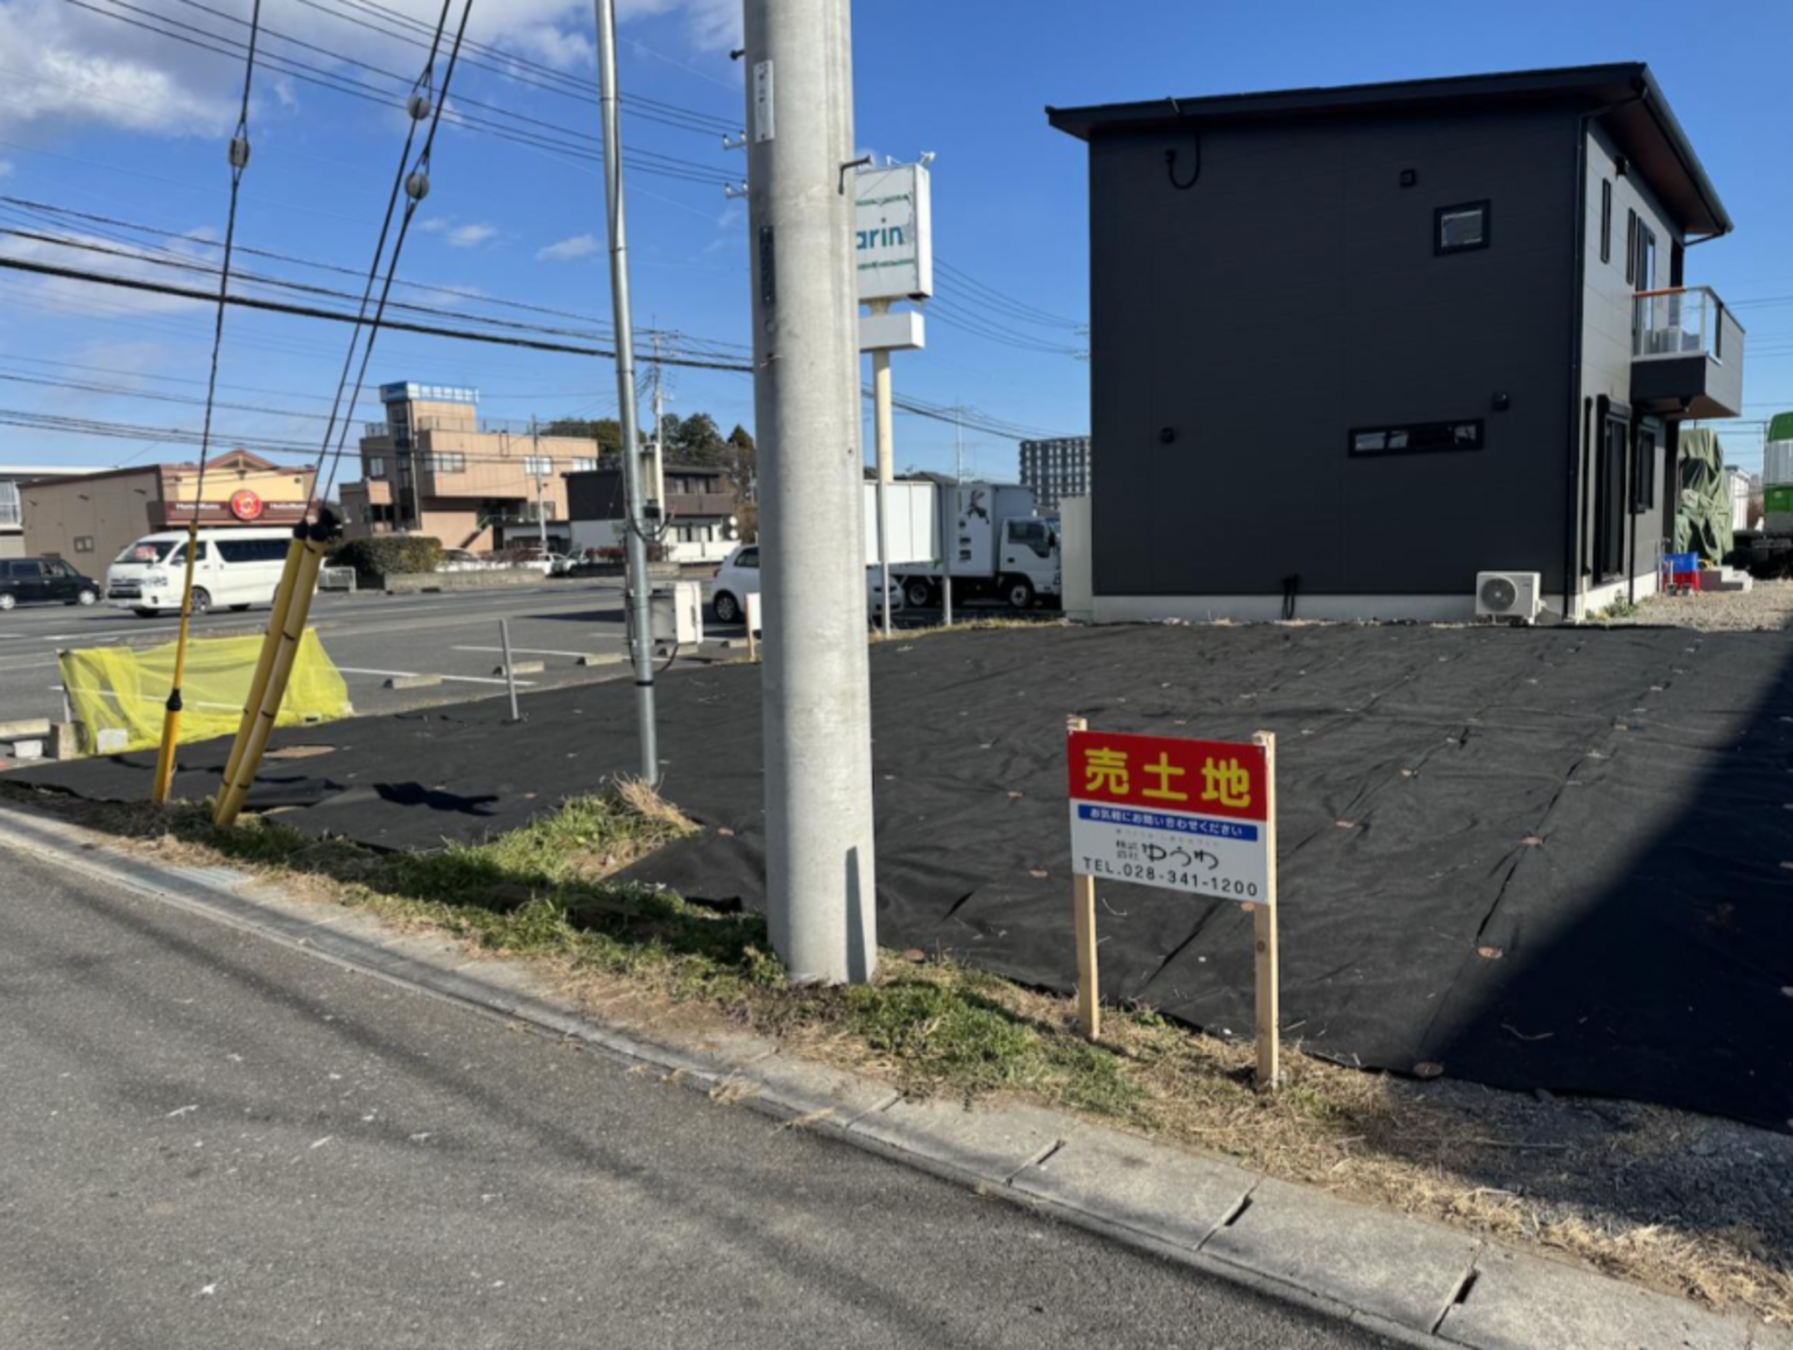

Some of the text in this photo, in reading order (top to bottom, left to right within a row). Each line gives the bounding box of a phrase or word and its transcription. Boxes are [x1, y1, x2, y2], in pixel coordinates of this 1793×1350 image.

[1084, 747, 1251, 808] 売土地
[1090, 807, 1243, 836] お気軽にお問い合わせください
[1082, 856, 1258, 897] TEL.028-341-1200
